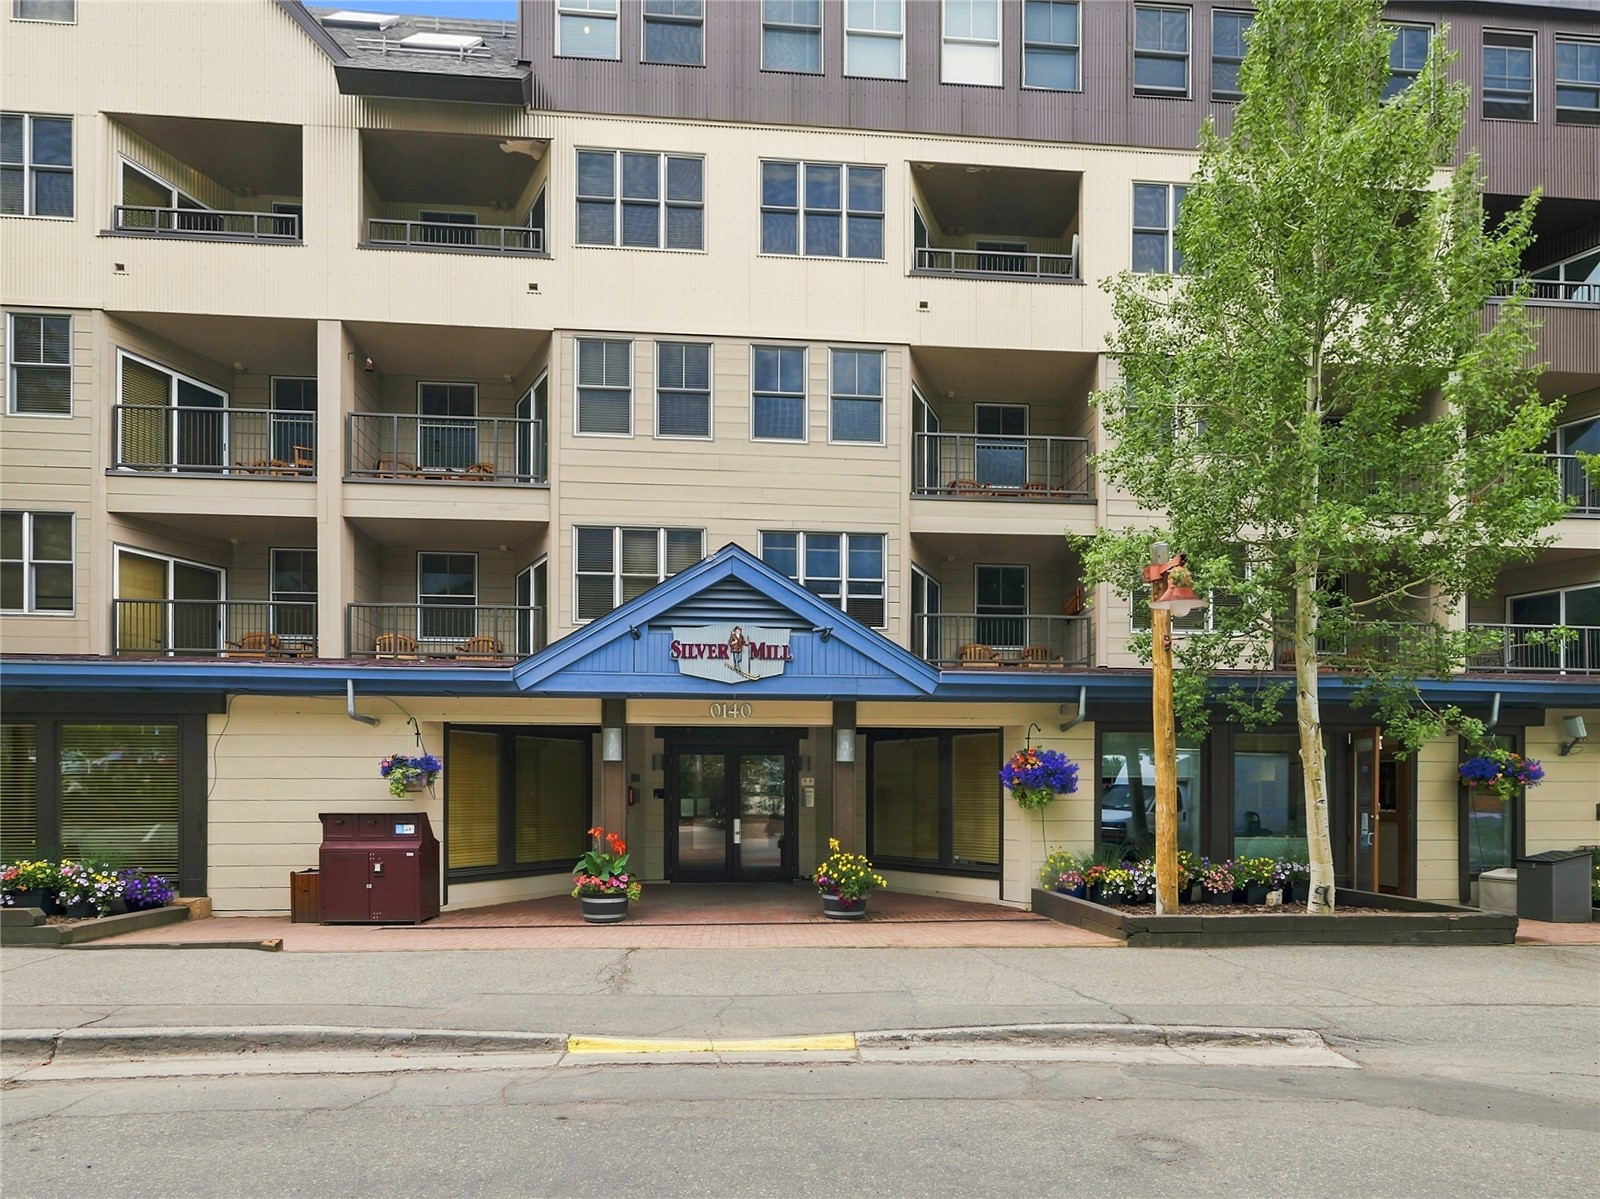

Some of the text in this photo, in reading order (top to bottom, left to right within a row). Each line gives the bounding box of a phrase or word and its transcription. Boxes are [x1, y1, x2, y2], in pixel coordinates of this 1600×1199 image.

[671, 640, 792, 660] SILVER MILL
[710, 702, 752, 718] 0140
